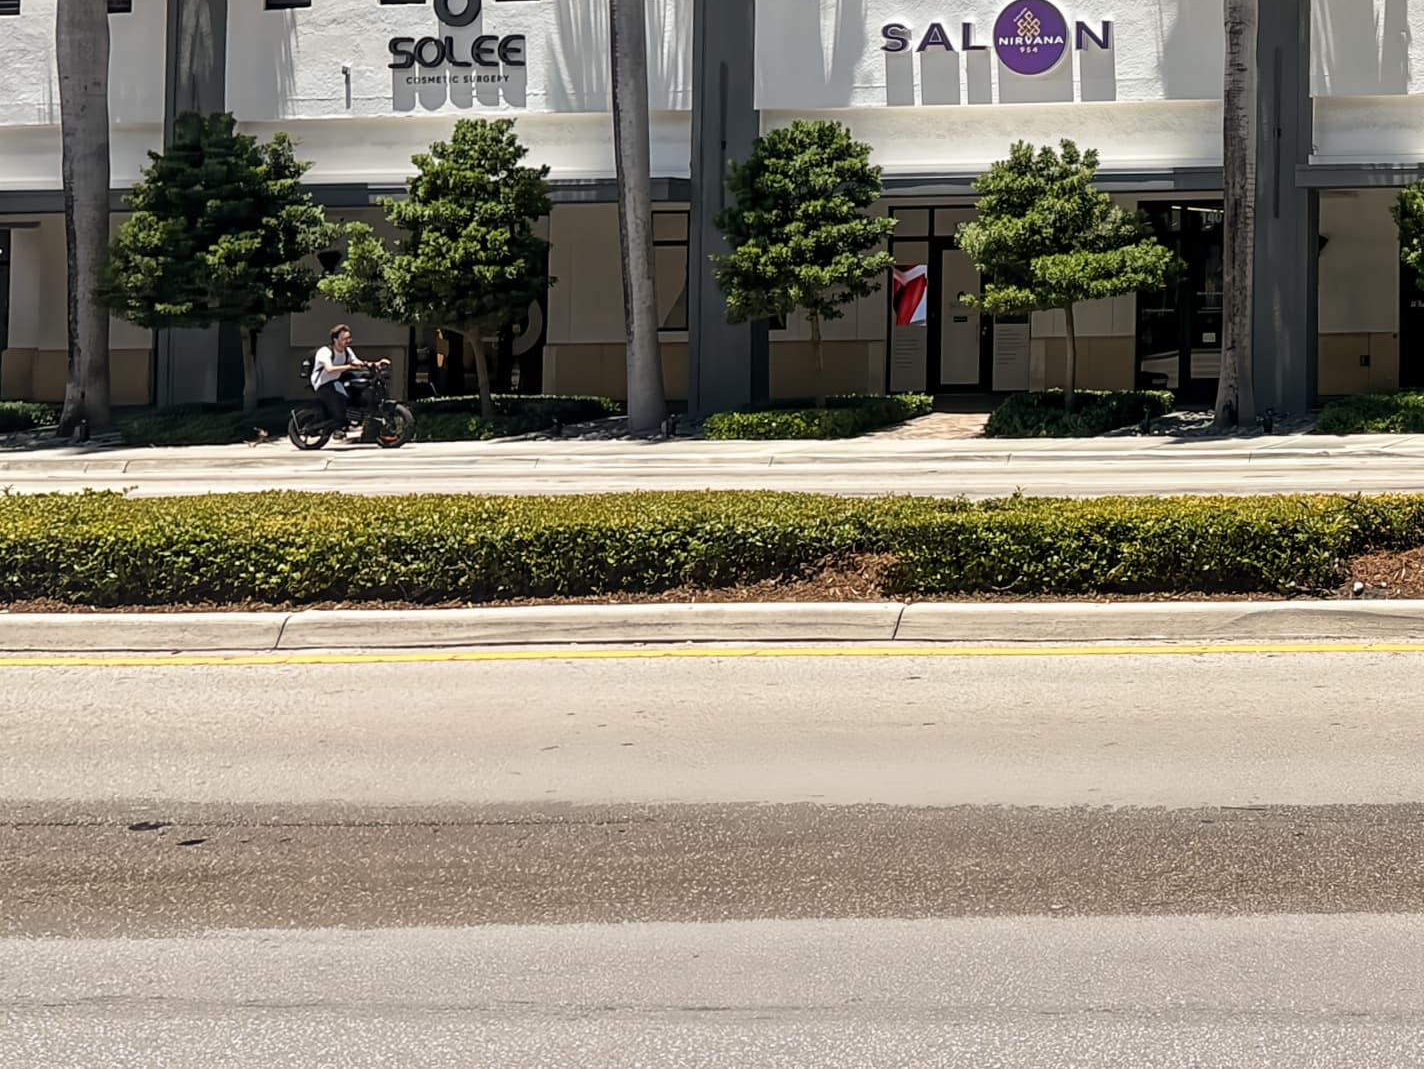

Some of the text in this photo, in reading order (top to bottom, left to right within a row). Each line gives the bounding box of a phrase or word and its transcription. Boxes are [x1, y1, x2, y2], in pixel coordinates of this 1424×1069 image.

[998, 36, 1064, 46] NIRVANA
[388, 34, 526, 69] SOLEE
[405, 74, 510, 84] COSMETIC SURGERY
